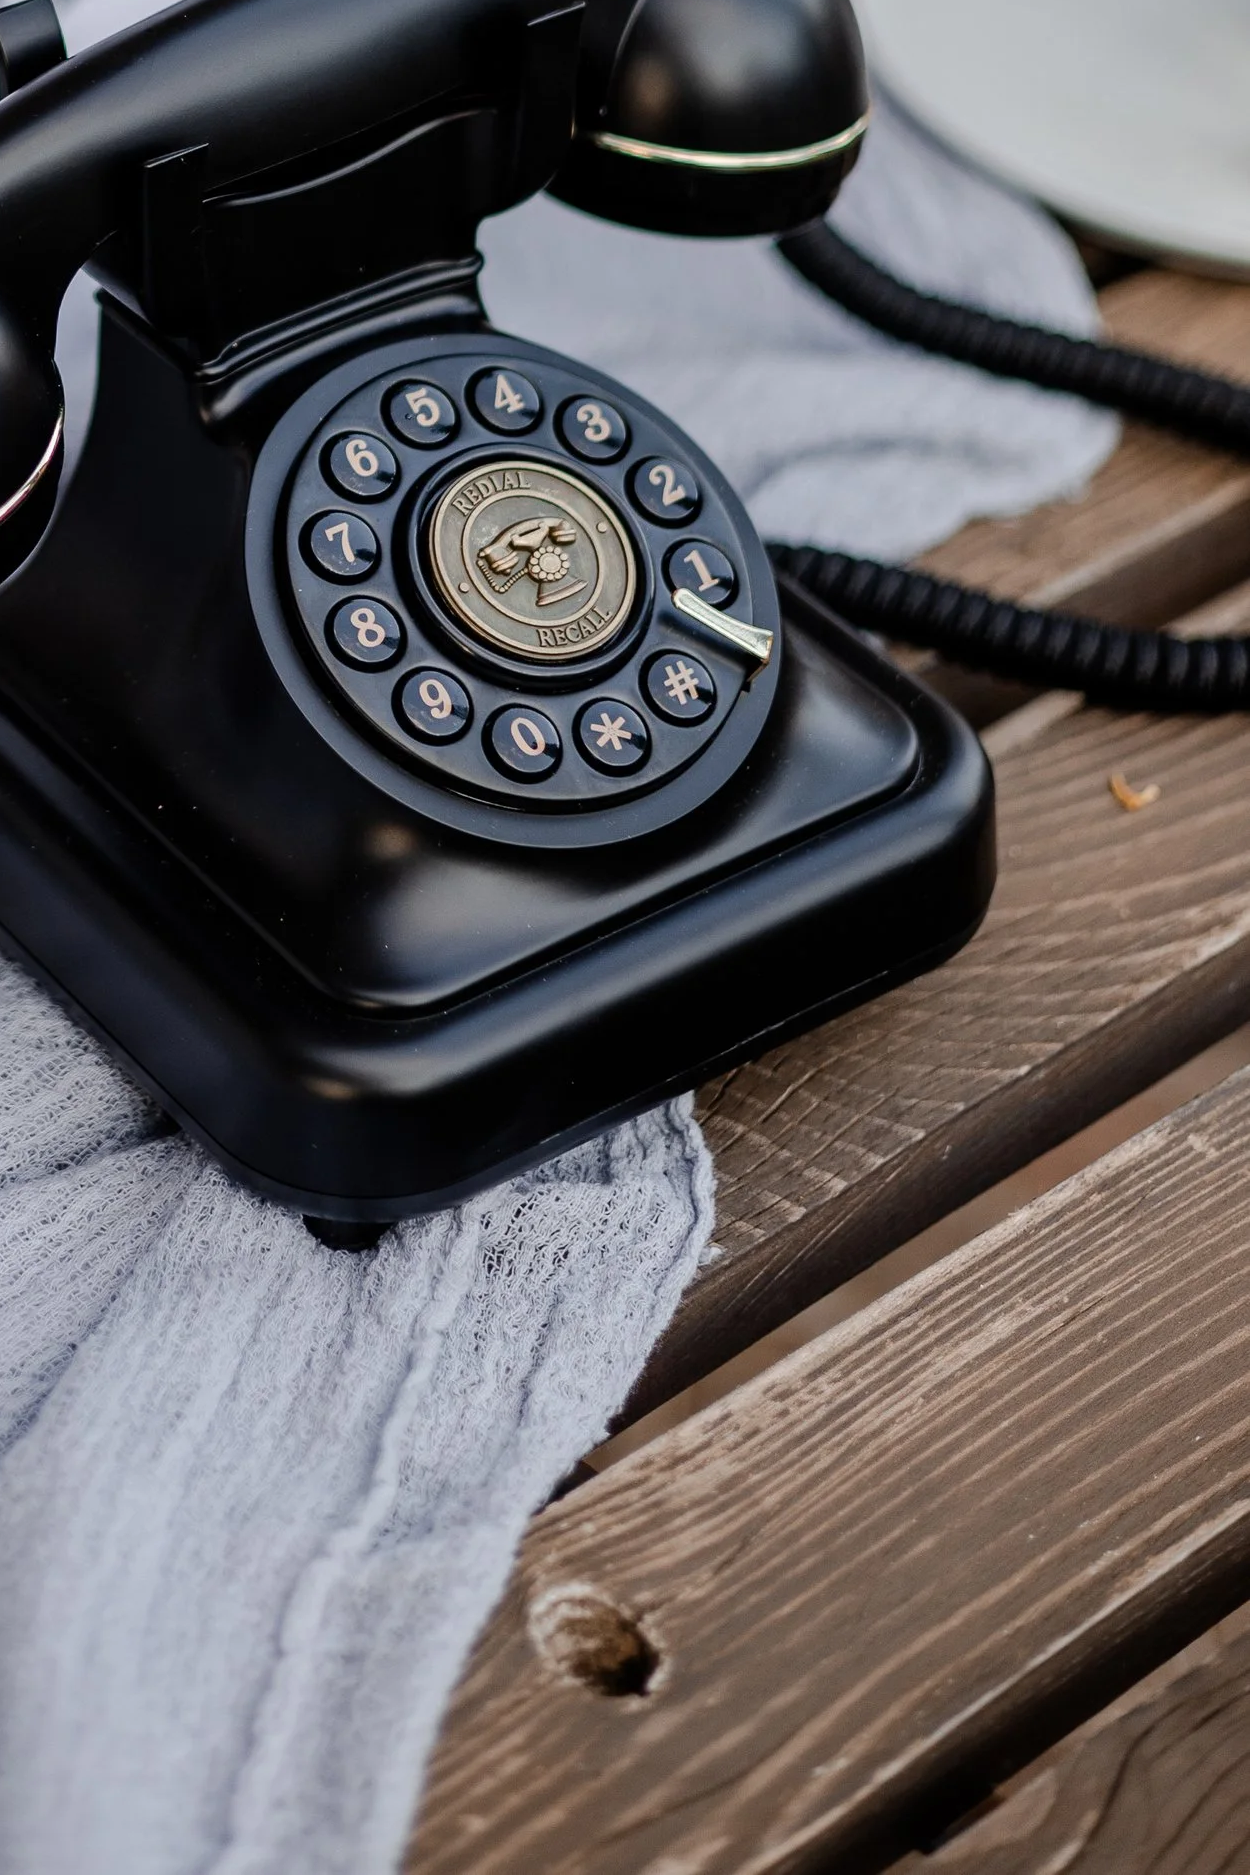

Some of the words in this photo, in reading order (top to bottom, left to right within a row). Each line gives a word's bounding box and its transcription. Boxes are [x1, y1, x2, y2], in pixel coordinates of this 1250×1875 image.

[404, 387, 442, 428] 5
[492, 374, 525, 415] 4
[576, 403, 612, 444] 3
[344, 438, 380, 479] 6
[452, 471, 531, 518] REDIAL
[647, 464, 685, 508] 2
[324, 521, 357, 565] 7
[684, 549, 721, 591] 1
[349, 606, 387, 649] 8
[535, 605, 613, 648] RECALL
[418, 678, 454, 720] 9
[509, 715, 547, 757] 0
